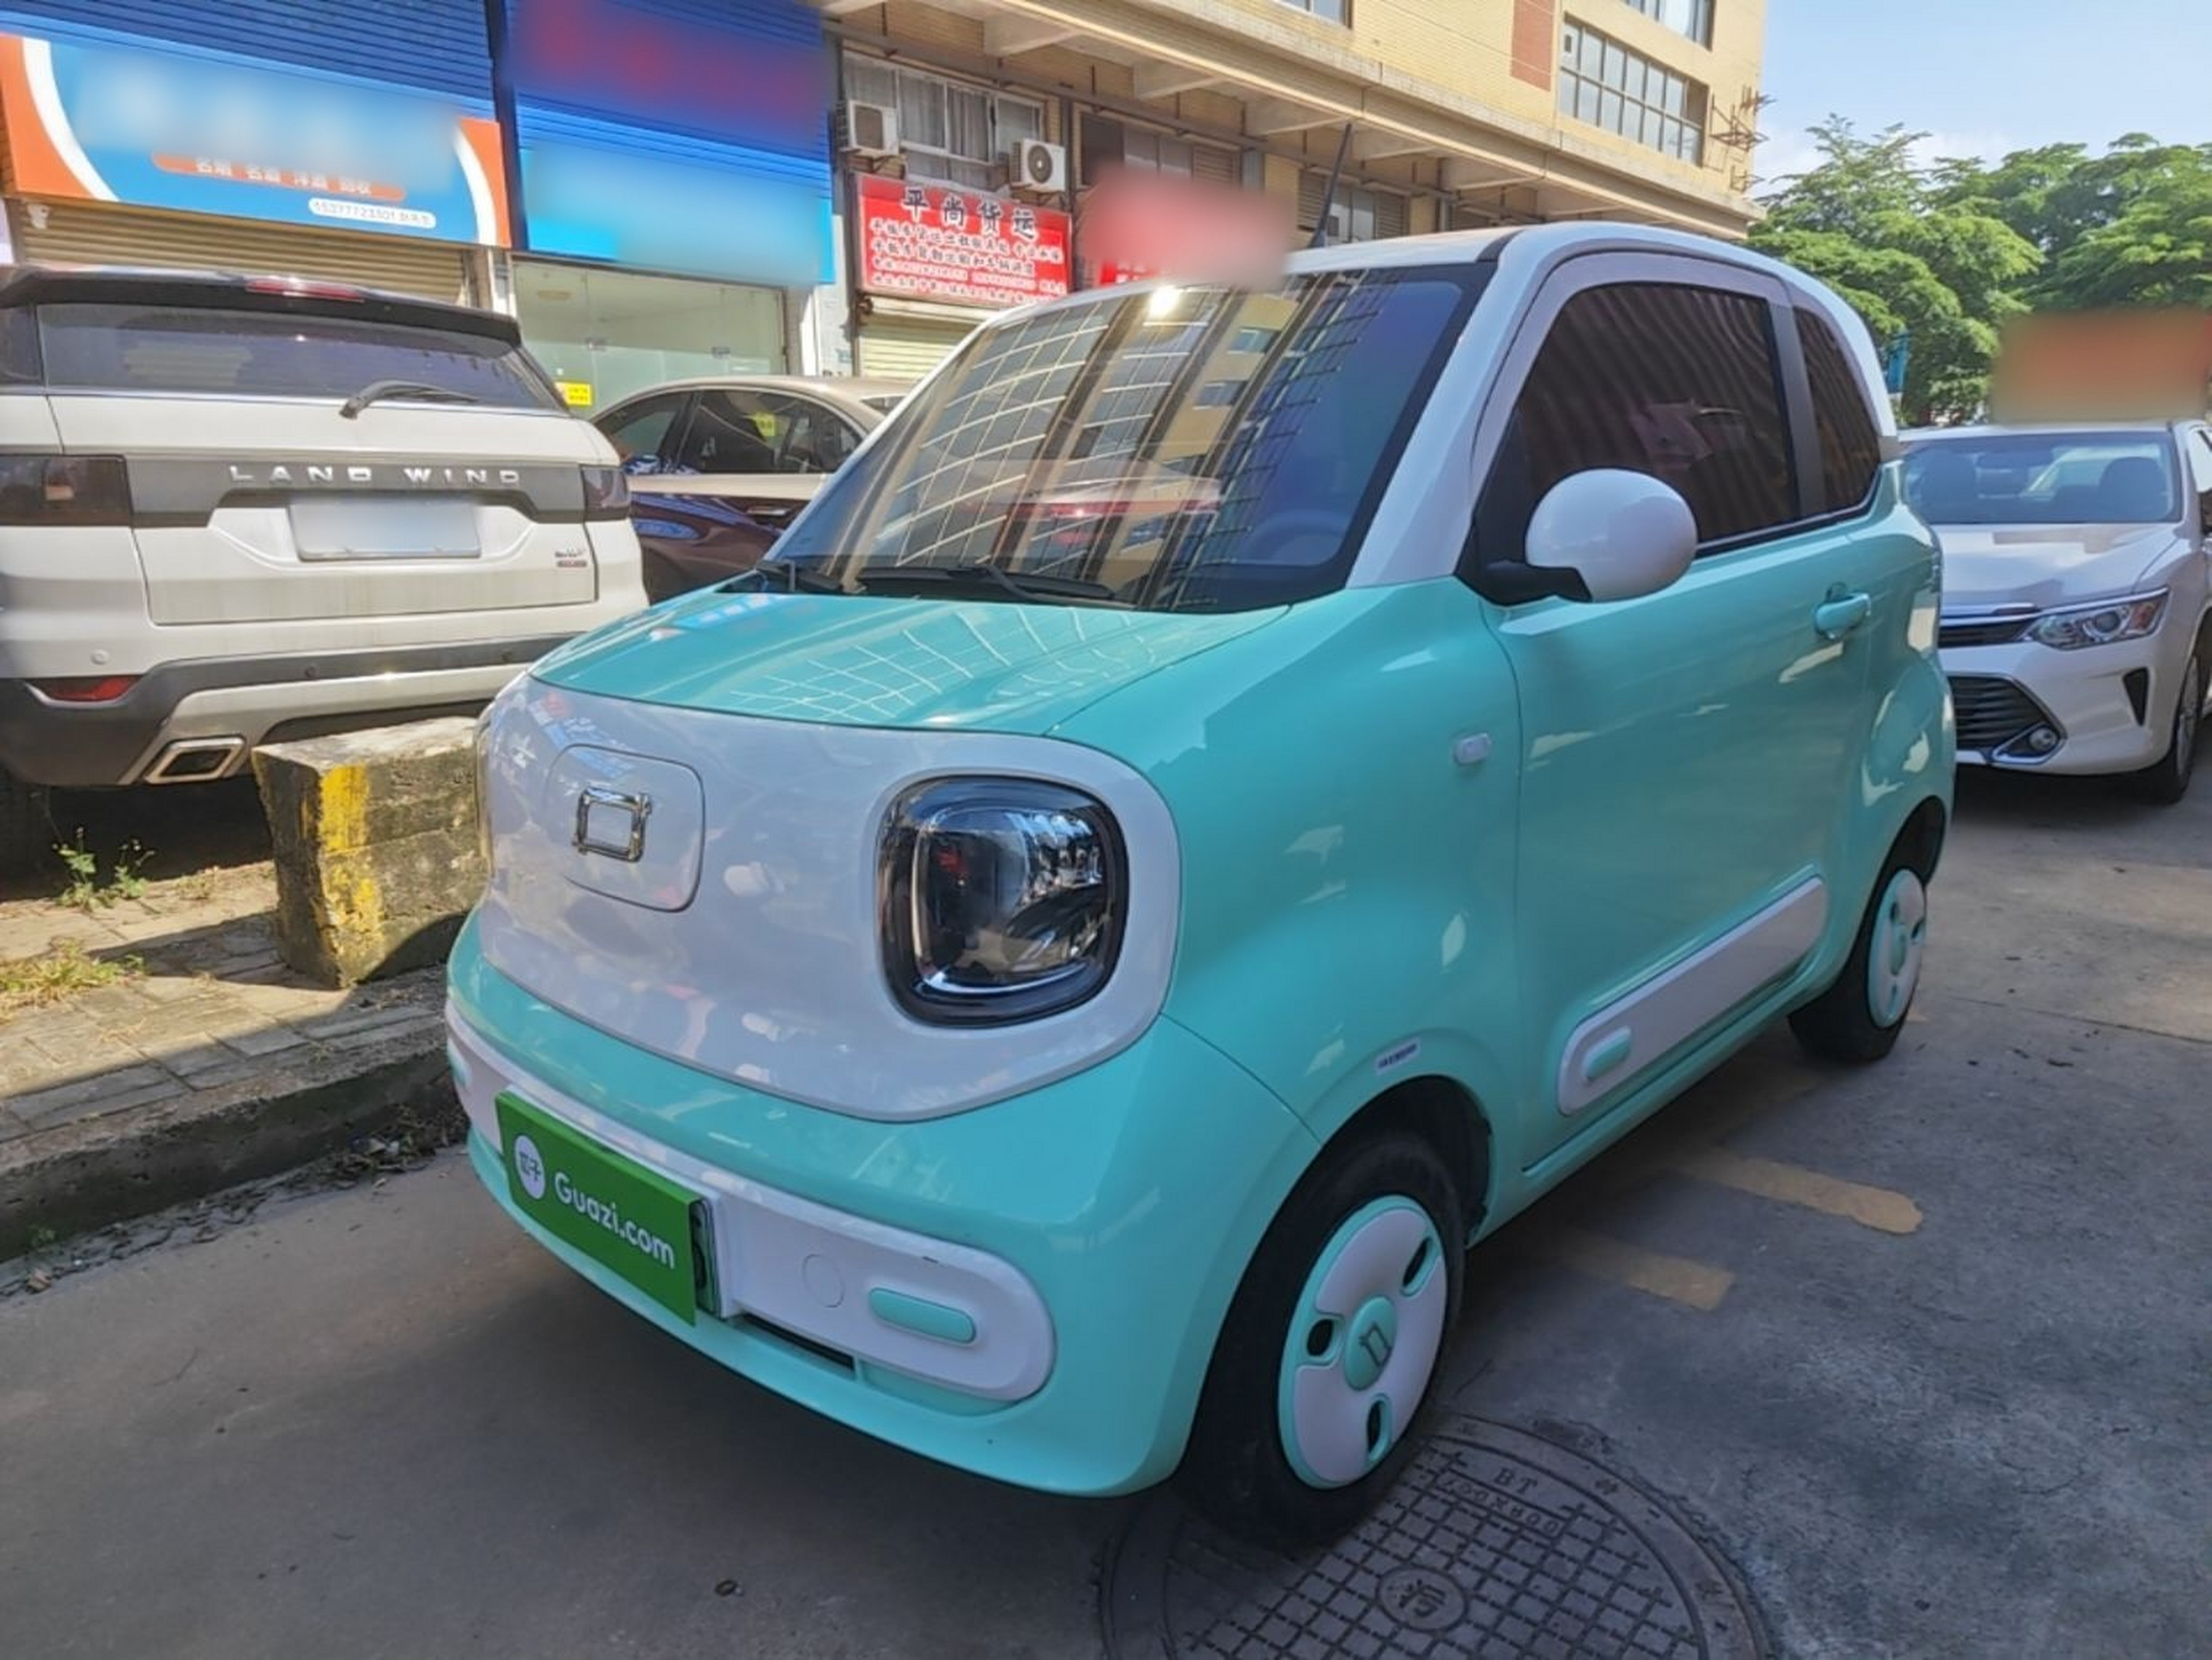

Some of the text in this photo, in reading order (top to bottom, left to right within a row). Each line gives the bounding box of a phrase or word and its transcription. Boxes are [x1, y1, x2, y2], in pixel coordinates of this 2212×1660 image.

[902, 187, 1037, 241] 平尚货运
[229, 465, 521, 483] LAND WIND
[554, 1171, 676, 1270] Guazi.com
[1494, 1467, 1539, 1495] BT
